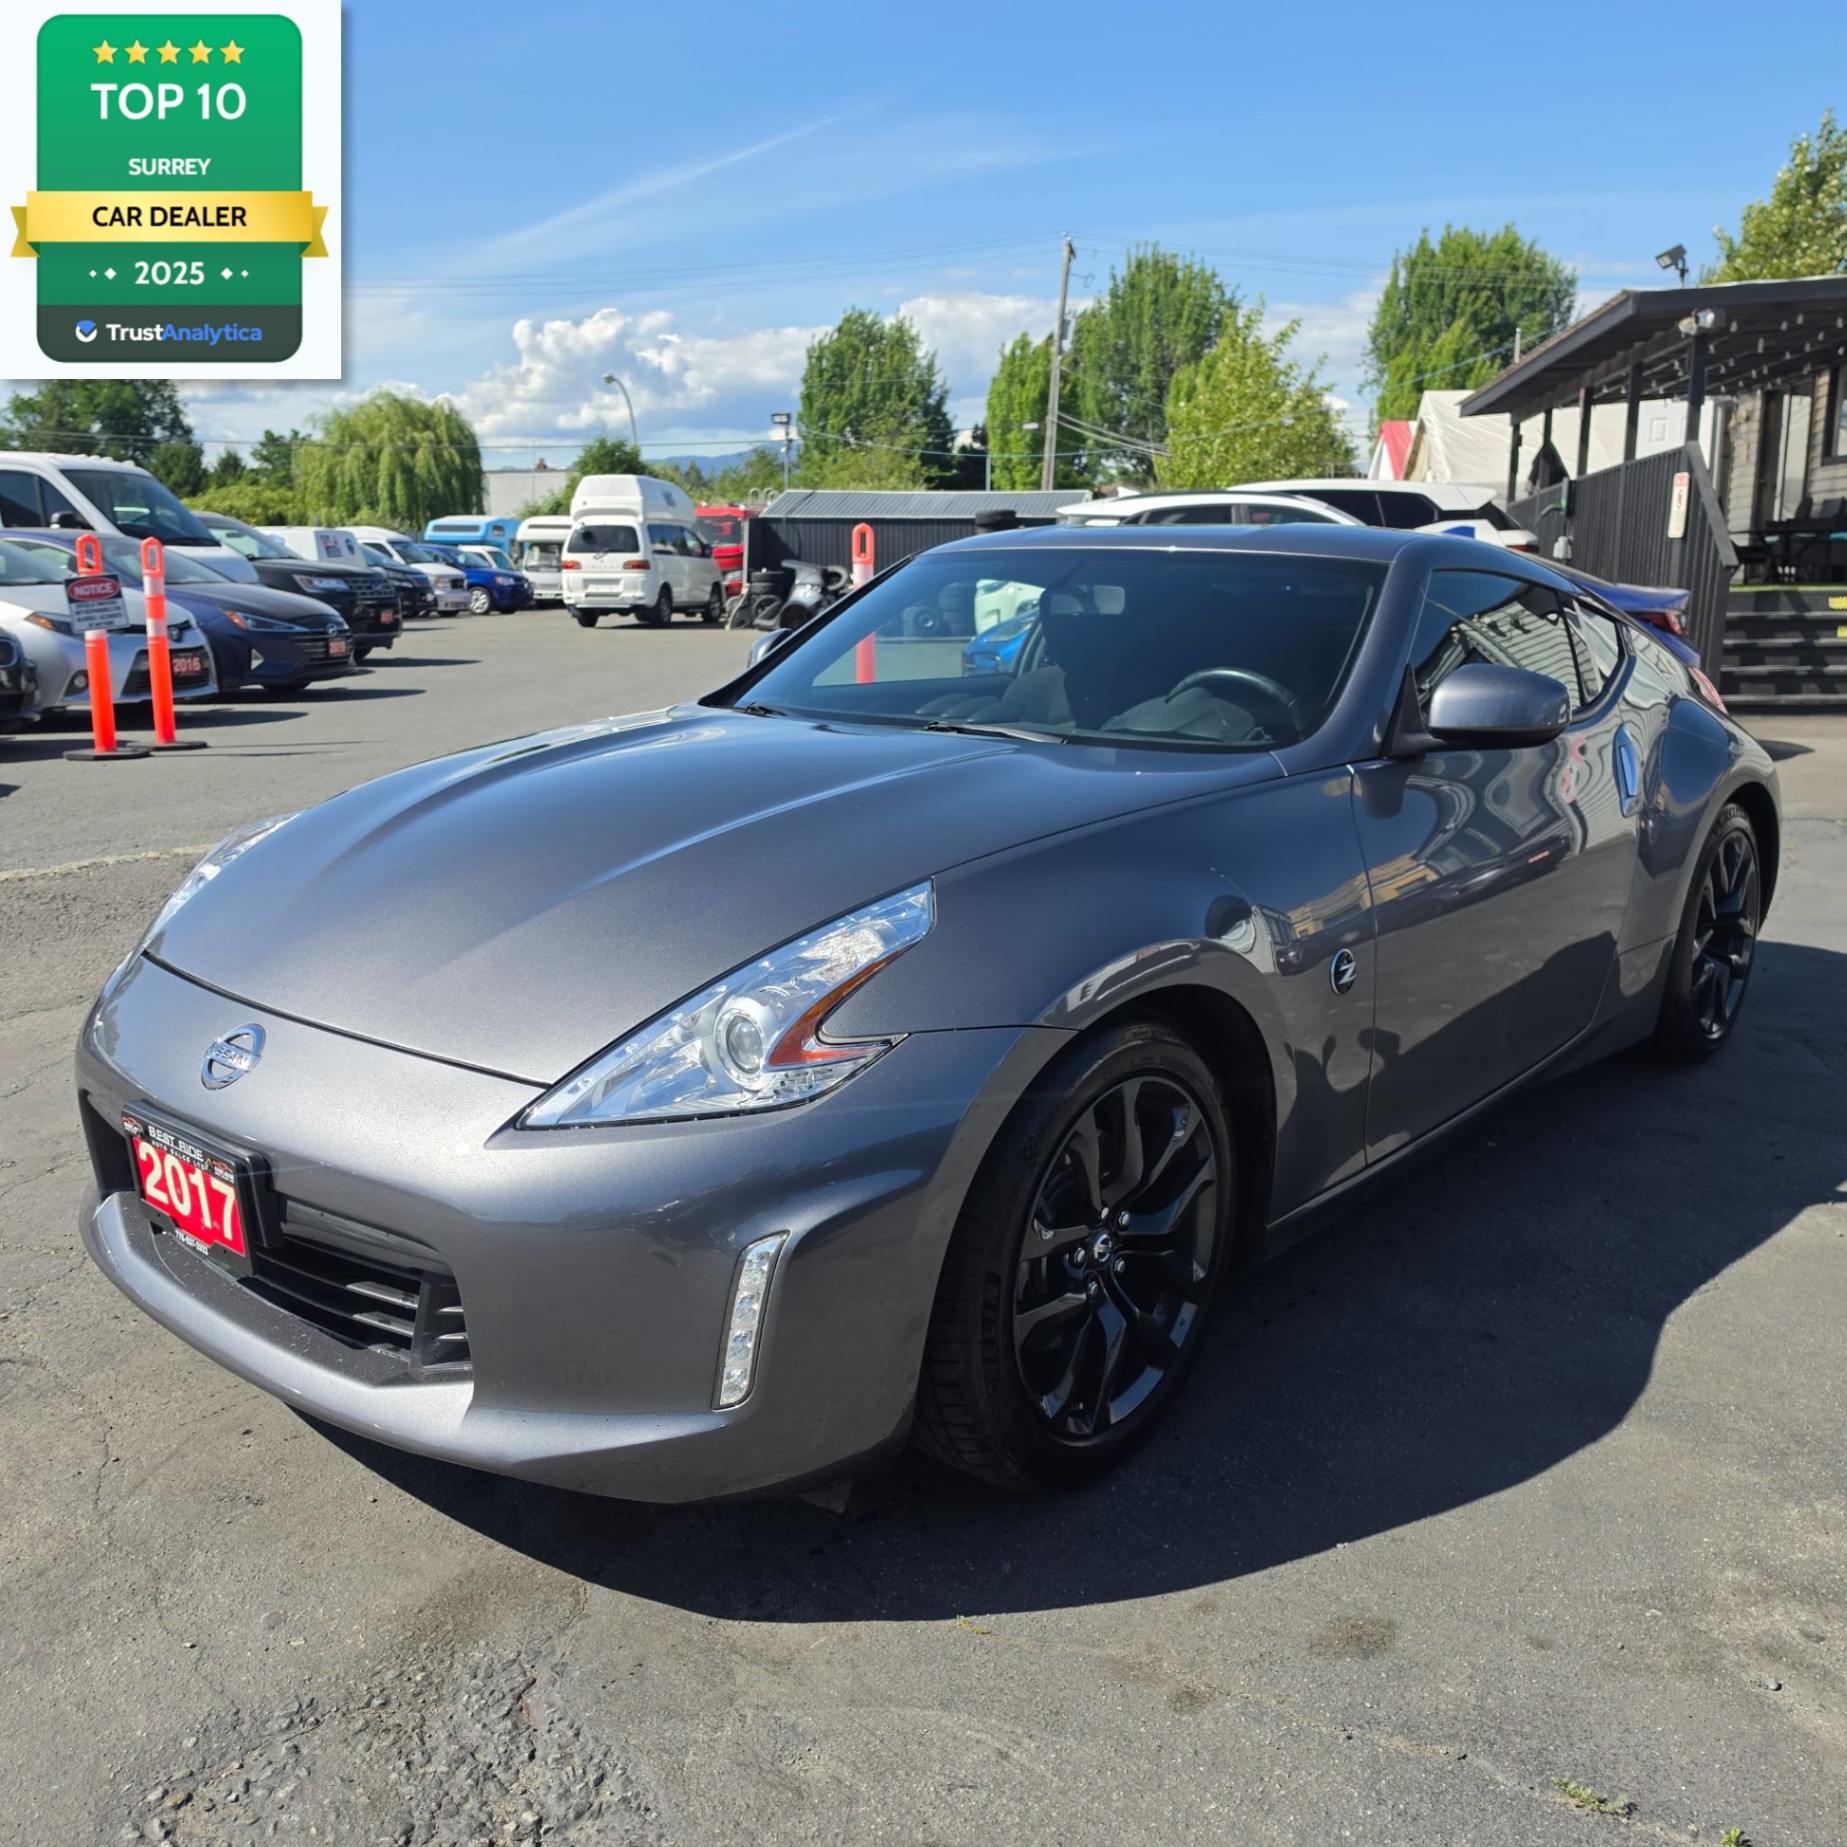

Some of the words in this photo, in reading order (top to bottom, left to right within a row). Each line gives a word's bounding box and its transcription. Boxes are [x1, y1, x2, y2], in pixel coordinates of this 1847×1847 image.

[73, 582, 113, 596] NOTICE
[172, 656, 202, 672] 2016
[147, 1125, 175, 1146] BEST
[139, 1141, 236, 1241] 2017
